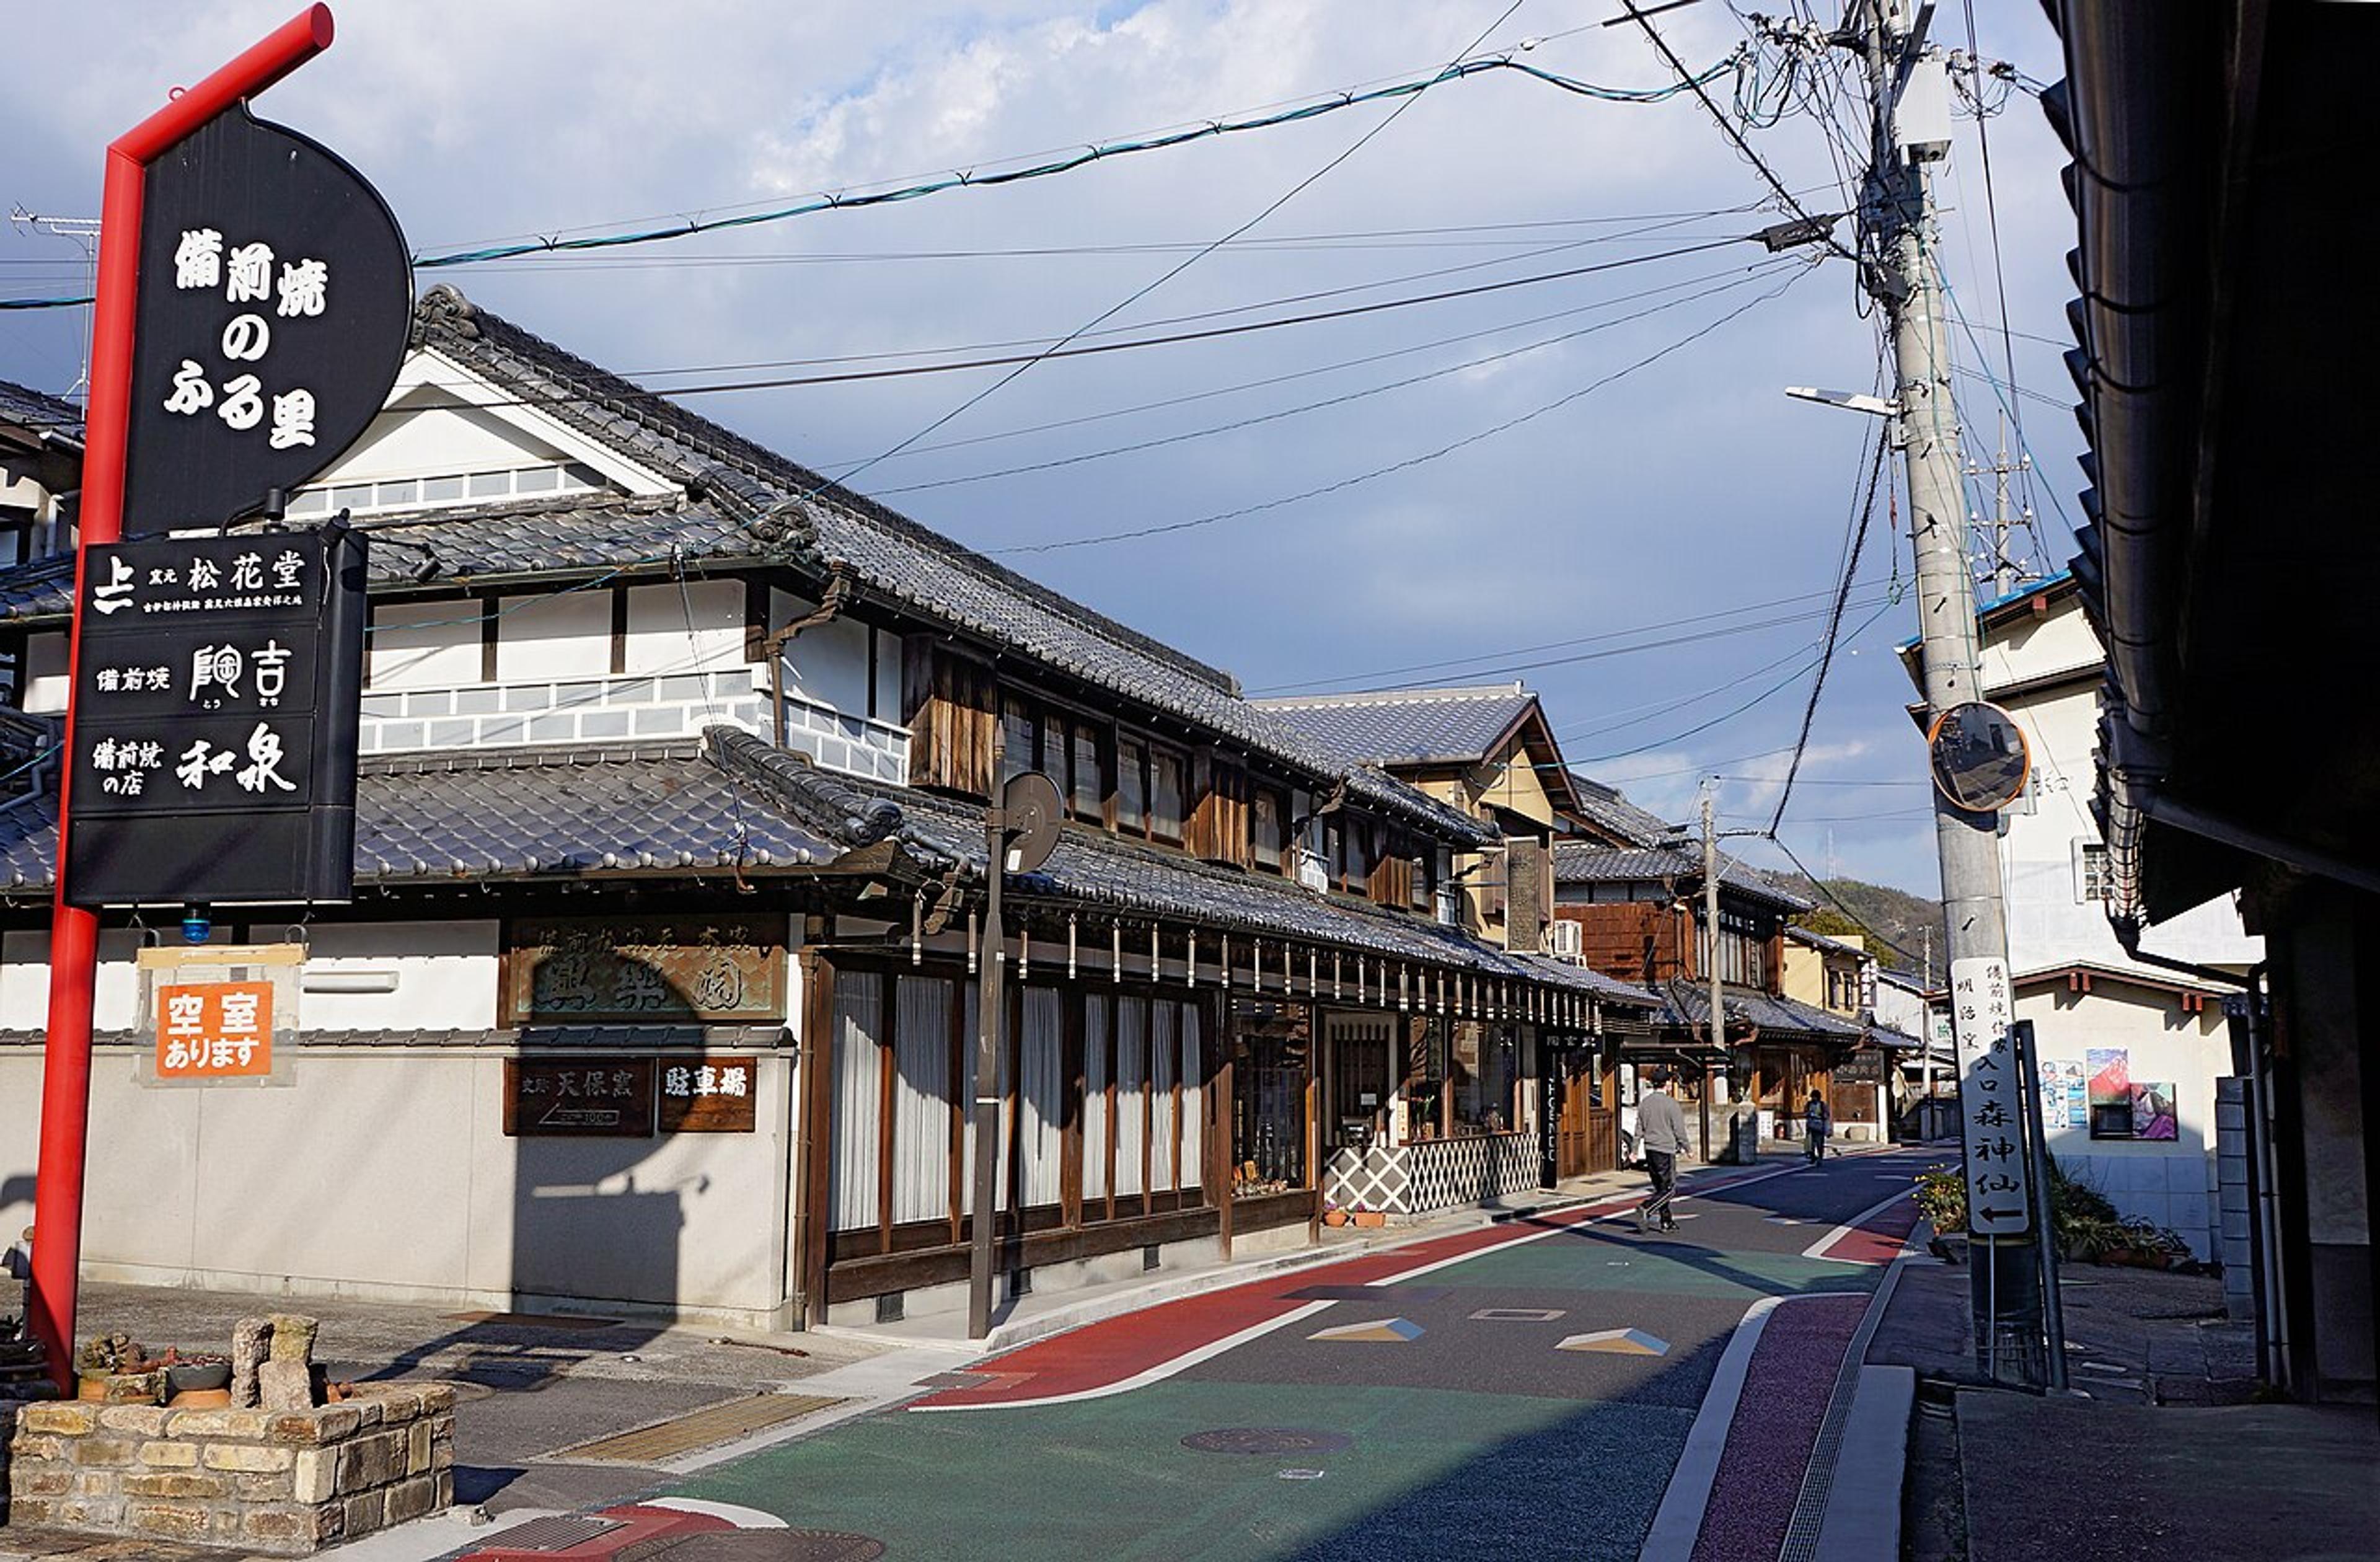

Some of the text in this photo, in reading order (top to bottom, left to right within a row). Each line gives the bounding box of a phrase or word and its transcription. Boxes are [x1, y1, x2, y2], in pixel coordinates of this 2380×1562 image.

[175, 229, 328, 317] 備前焼
[222, 314, 270, 361] の
[164, 360, 315, 449] ふる里
[188, 550, 306, 591] 松花堂
[97, 667, 171, 692] 備前焼
[93, 721, 298, 793] 備前焼 和泉
[103, 767, 144, 796] の店
[167, 992, 258, 1035] 空室
[165, 1036, 259, 1069] あります
